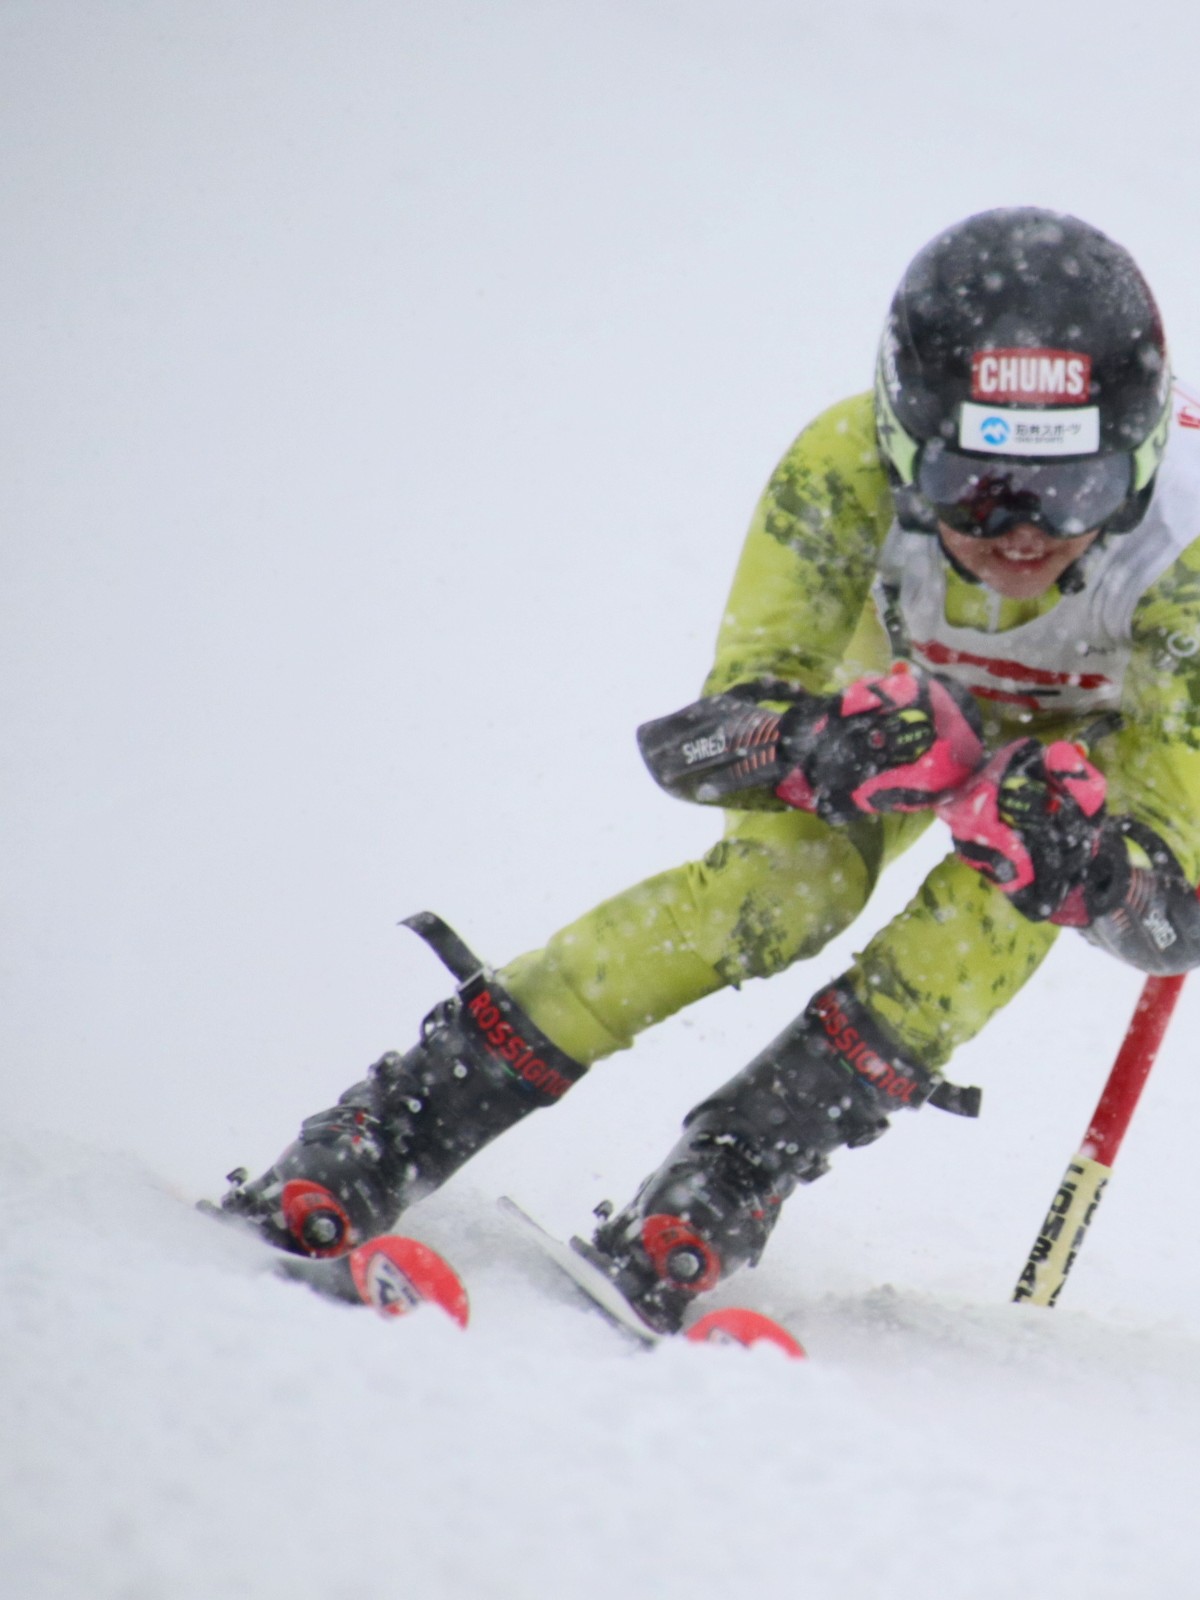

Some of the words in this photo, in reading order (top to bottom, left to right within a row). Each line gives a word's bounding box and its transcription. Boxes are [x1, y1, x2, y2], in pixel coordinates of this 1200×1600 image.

[979, 356, 1084, 395] CHUMS
[682, 731, 726, 765] SHRED
[468, 989, 573, 1097] ROSSIGNO
